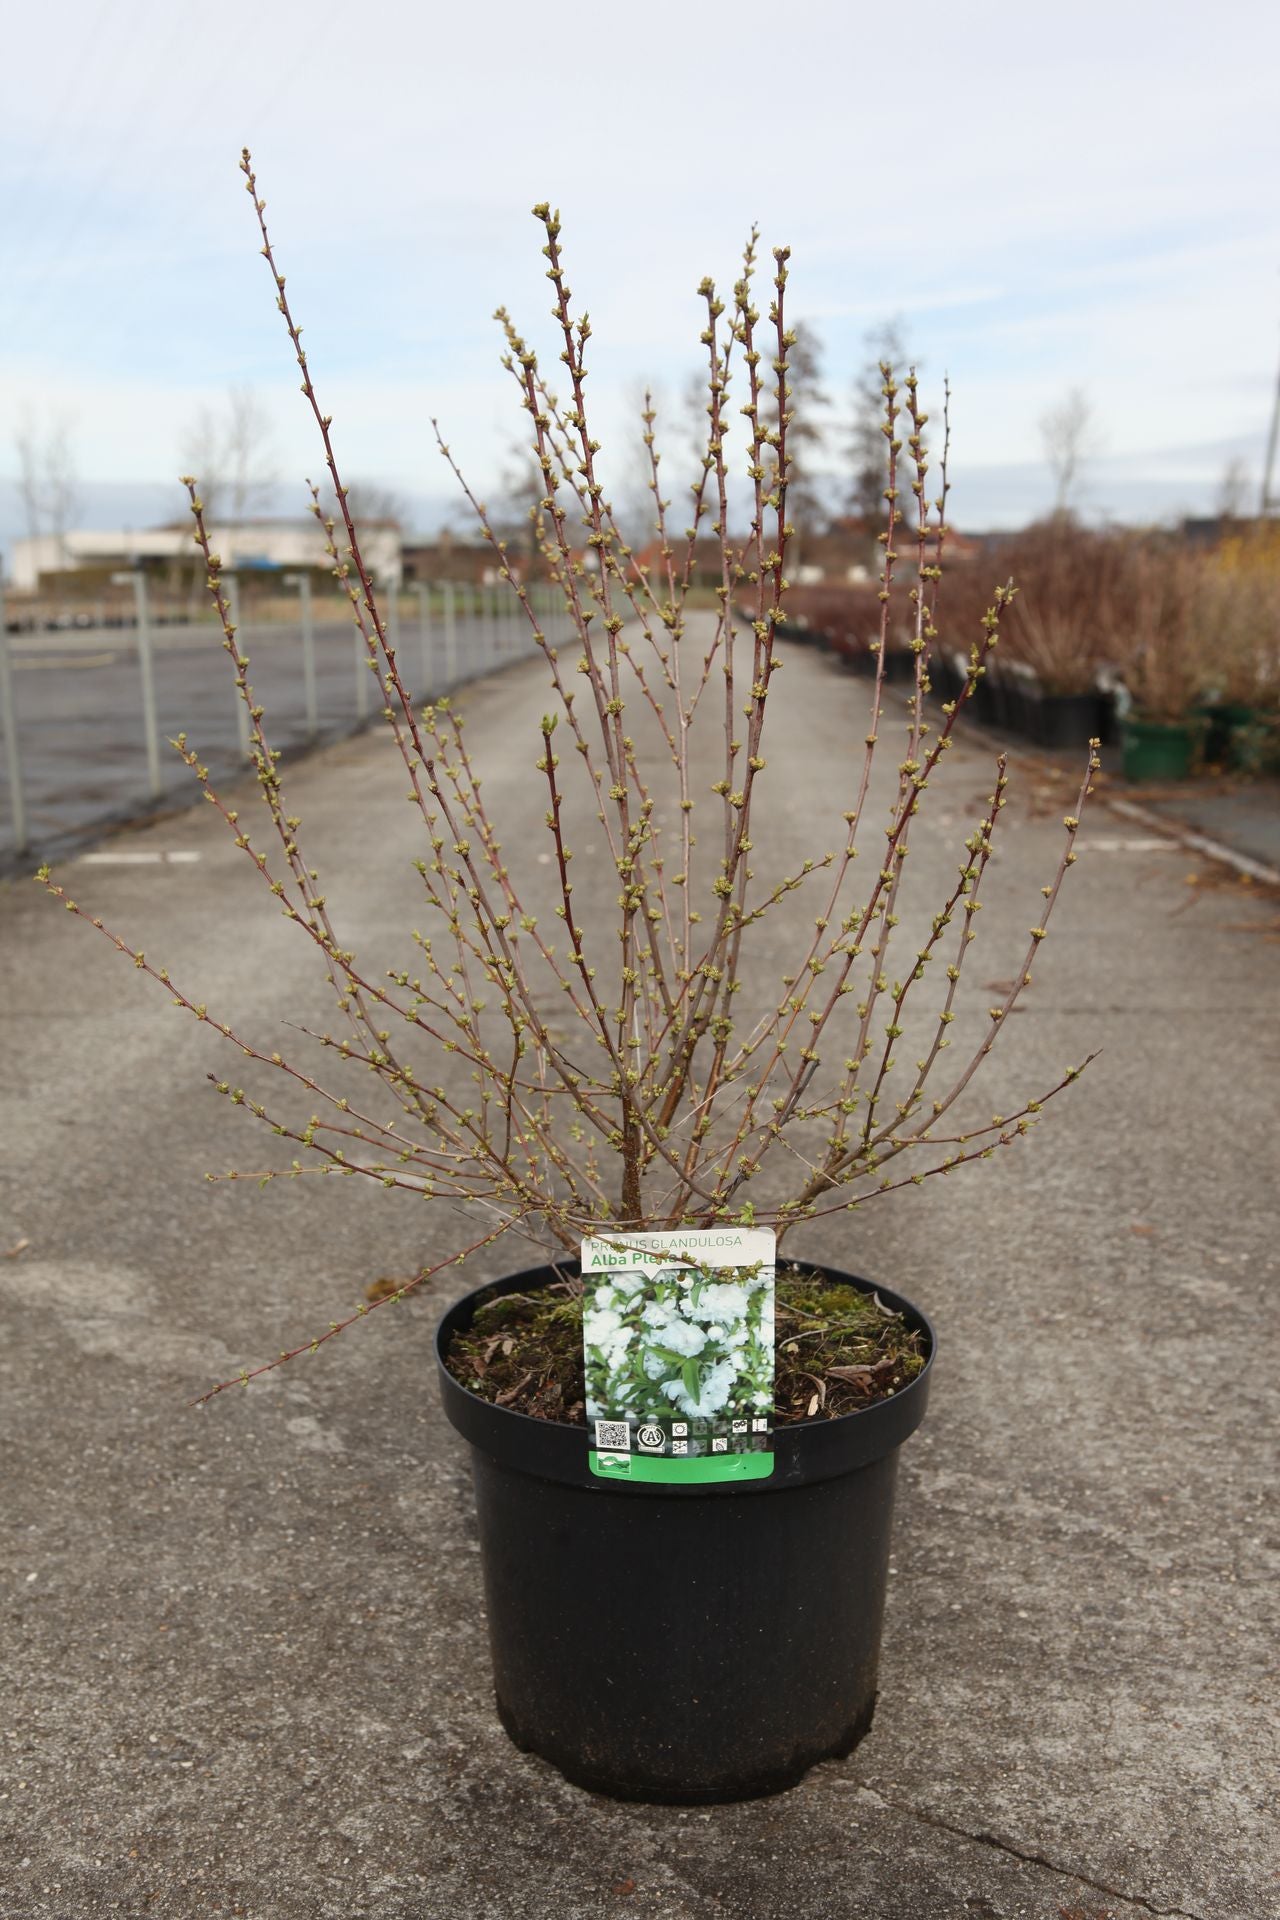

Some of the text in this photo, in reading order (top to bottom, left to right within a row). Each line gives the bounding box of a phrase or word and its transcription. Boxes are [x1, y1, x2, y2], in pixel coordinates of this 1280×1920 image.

[591, 1236, 742, 1251] PRNUS GLANDULOSA
[591, 1254, 627, 1266] Alba
